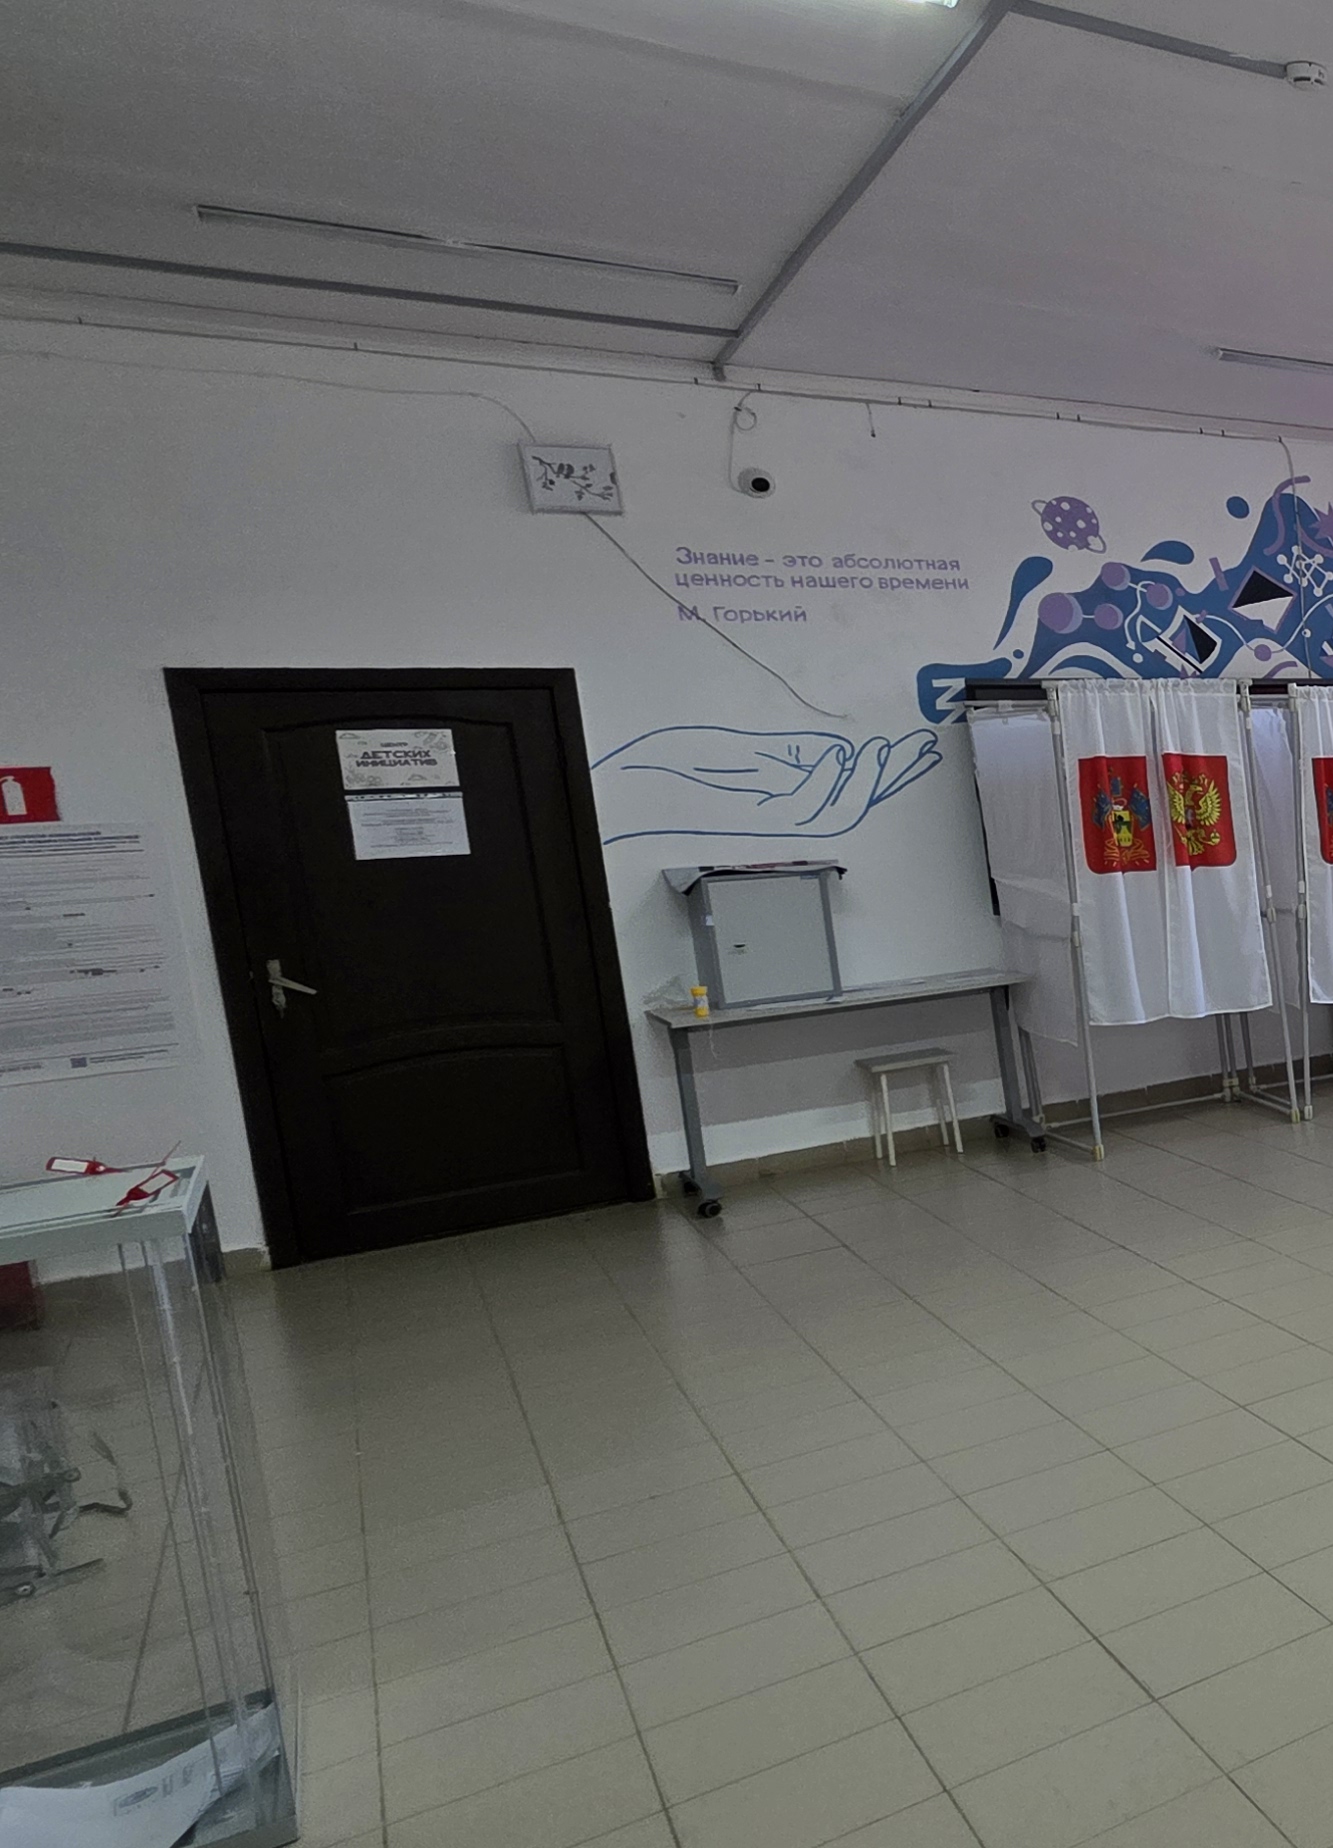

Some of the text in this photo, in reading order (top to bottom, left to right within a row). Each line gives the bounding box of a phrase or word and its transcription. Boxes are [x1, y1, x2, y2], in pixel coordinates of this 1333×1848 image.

[676, 546, 760, 567] Знание
[782, 554, 823, 568] это
[831, 553, 961, 571] абсолютная
[675, 573, 969, 591] ценность нашего времени
[713, 605, 807, 623] Горький
[355, 759, 438, 768] ИНИЦИАТИВ
[360, 749, 431, 760] ДЕТСКИХ
